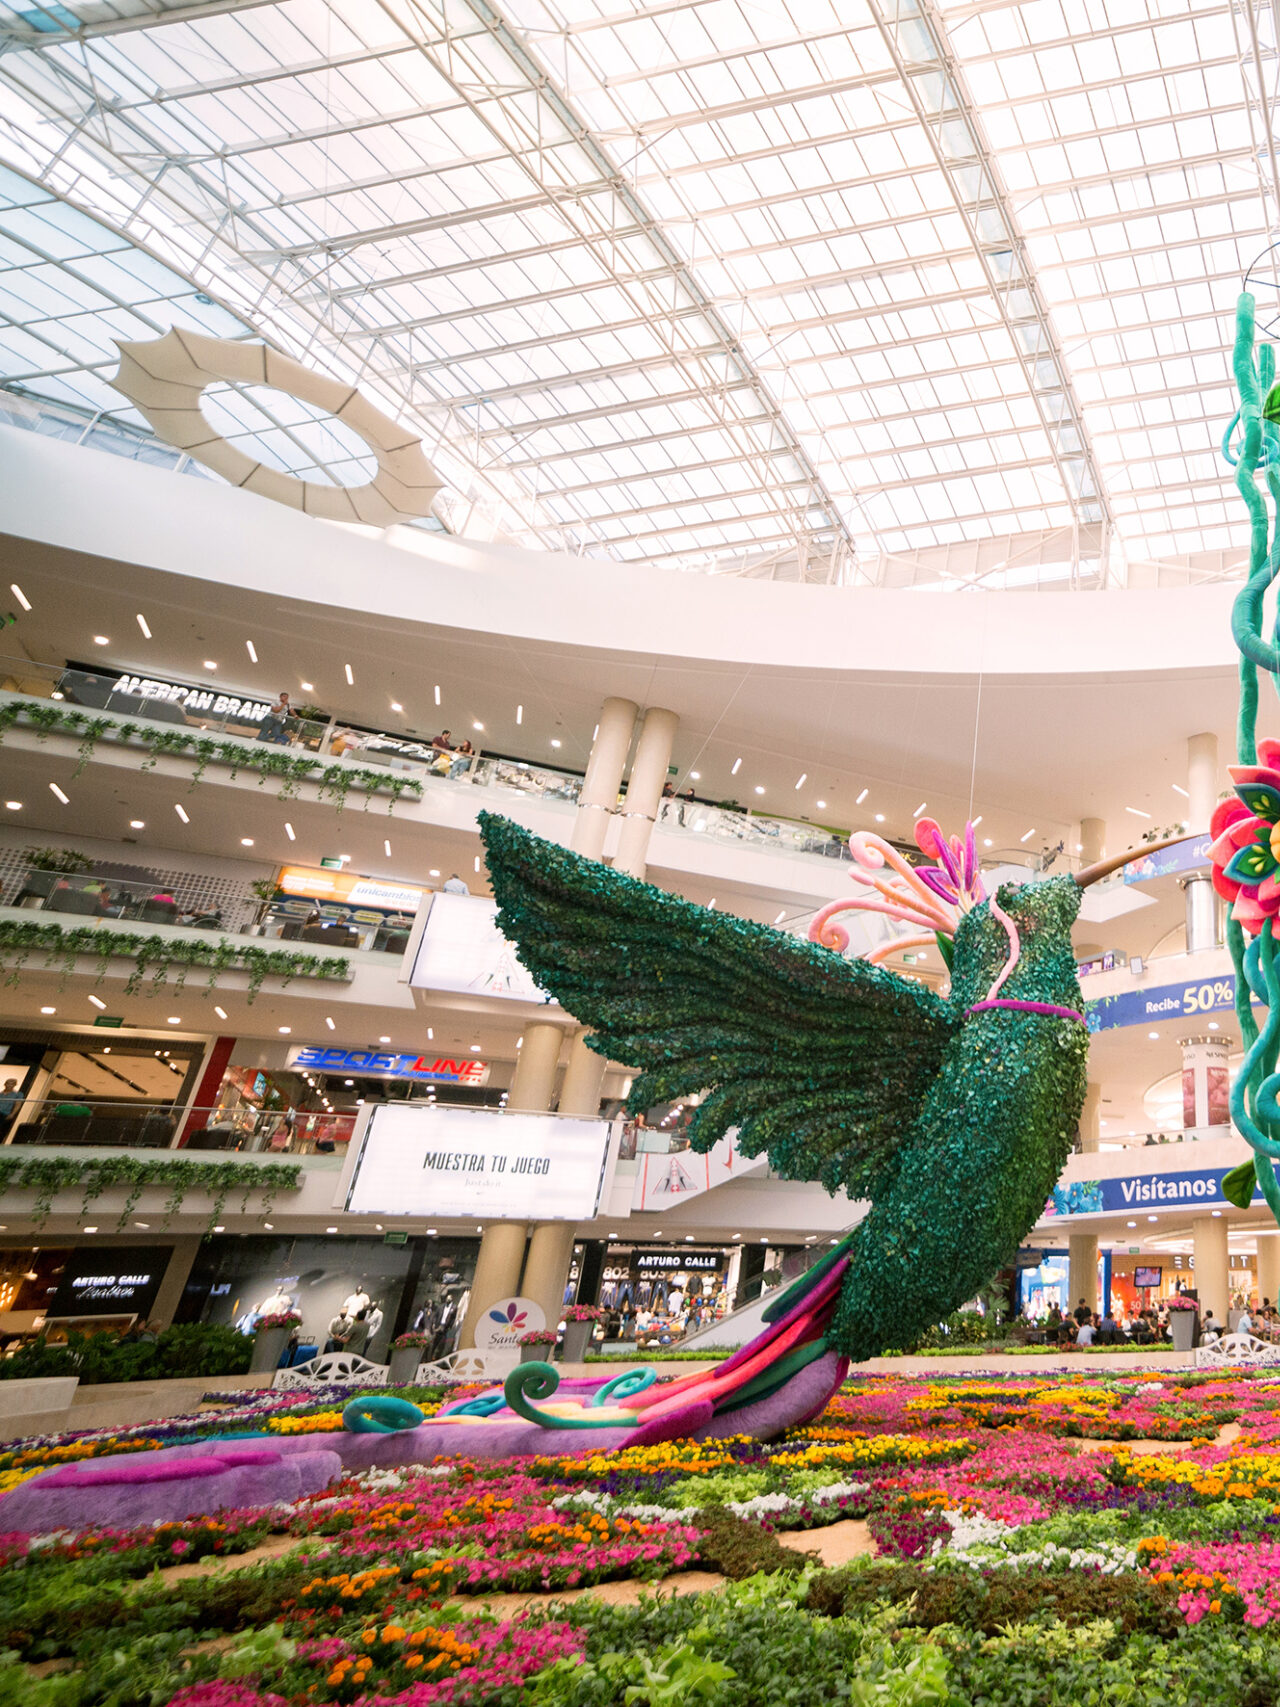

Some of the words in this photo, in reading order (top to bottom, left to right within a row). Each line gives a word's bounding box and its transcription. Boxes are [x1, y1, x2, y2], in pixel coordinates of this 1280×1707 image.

[112, 674, 215, 710] AMERICAN
[212, 695, 272, 722] BRAN
[1145, 998, 1181, 1014] Recibe
[1183, 980, 1234, 1014] 50%
[423, 1151, 486, 1173] MUESTRA
[491, 1155, 508, 1173] TU
[511, 1156, 551, 1175] JUEGO
[1120, 1176, 1217, 1203] Visítanos
[638, 1256, 682, 1268] ARTURO
[684, 1257, 717, 1268] CALLE
[72, 1275, 115, 1288] ARTURO
[118, 1275, 151, 1286] CALLE
